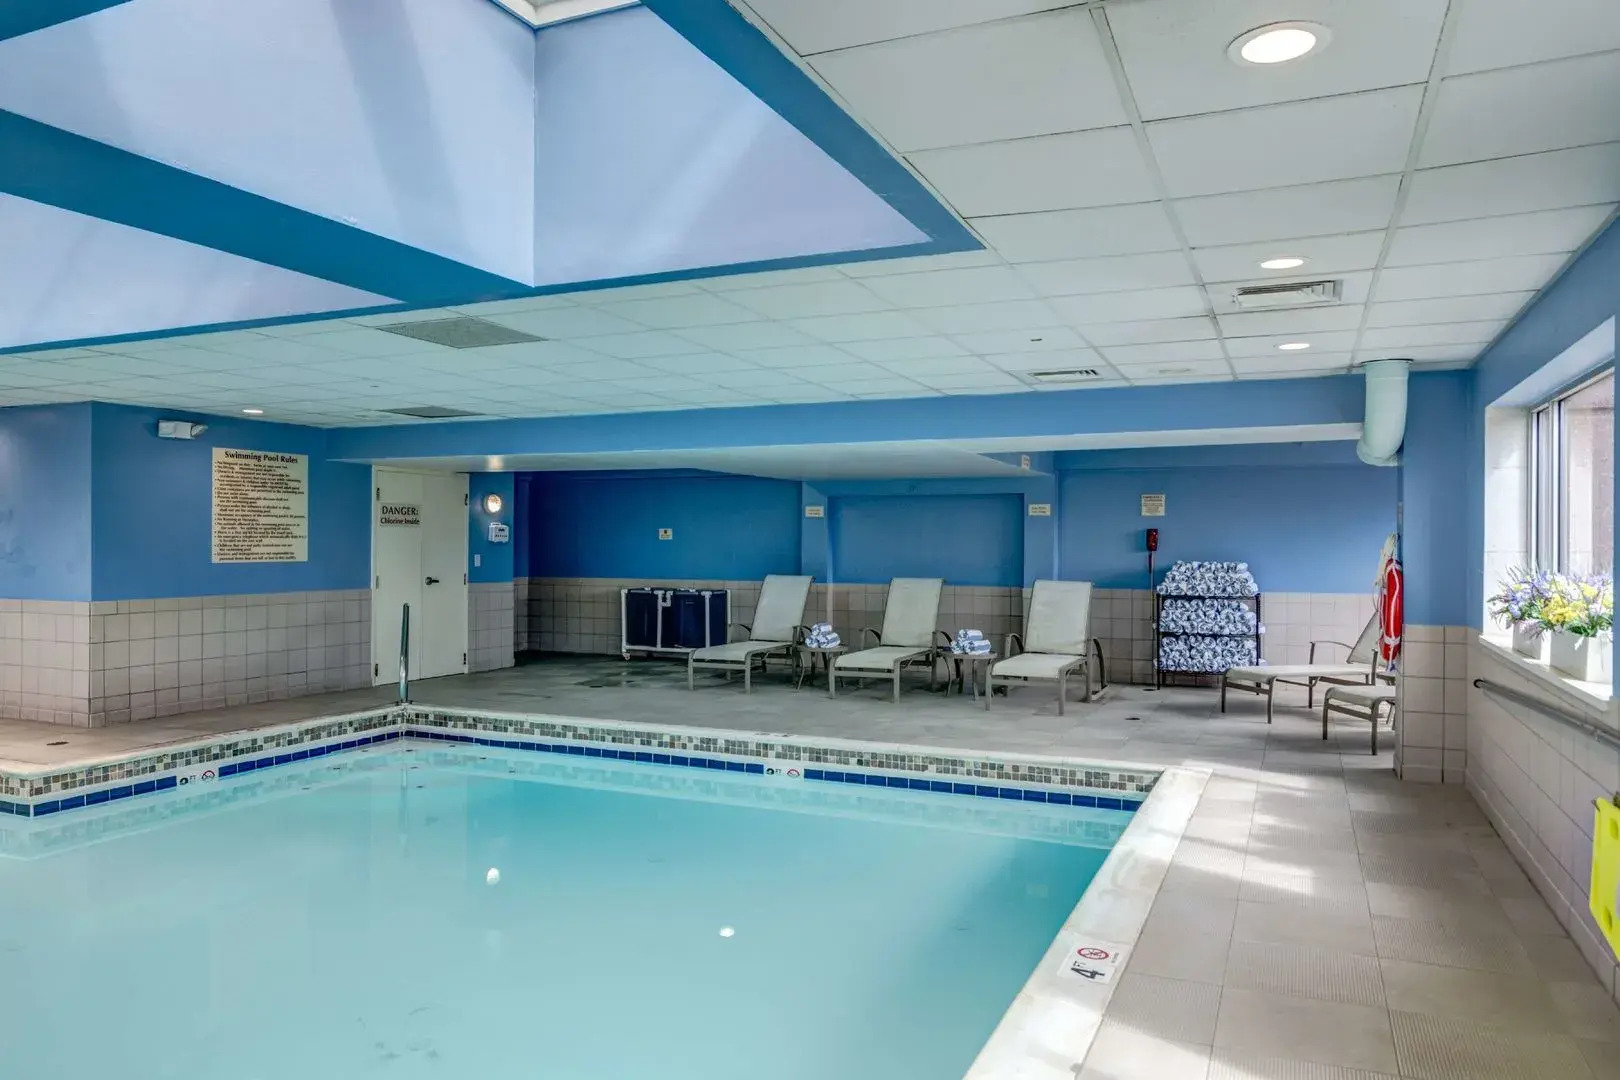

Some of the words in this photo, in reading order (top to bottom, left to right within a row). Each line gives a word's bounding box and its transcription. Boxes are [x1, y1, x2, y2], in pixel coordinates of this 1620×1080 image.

[224, 451, 262, 463] Swimming
[263, 454, 279, 462] Pool
[280, 455, 298, 463] Rules
[382, 505, 419, 516] DANGER:
[380, 517, 404, 525] Chlorine
[1071, 967, 1105, 979] 4
